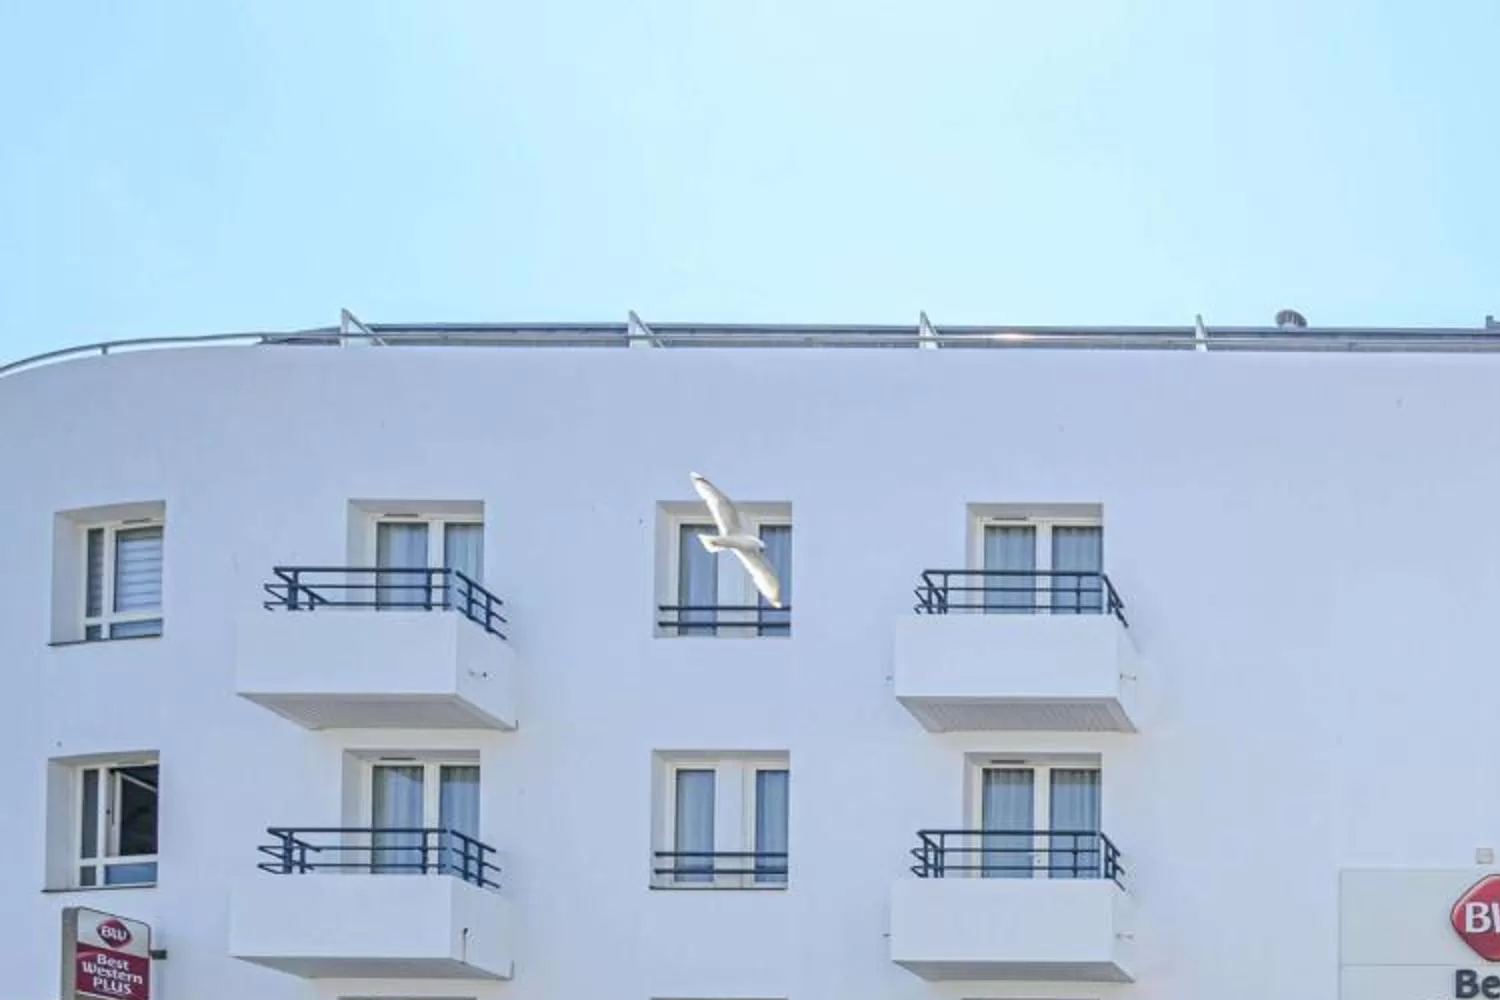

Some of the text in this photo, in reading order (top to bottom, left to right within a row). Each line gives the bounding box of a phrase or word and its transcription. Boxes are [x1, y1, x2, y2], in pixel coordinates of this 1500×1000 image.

[101, 926, 127, 942] BW
[97, 954, 129, 971] Best
[81, 961, 143, 985] Western
[93, 976, 132, 995] PLUS
